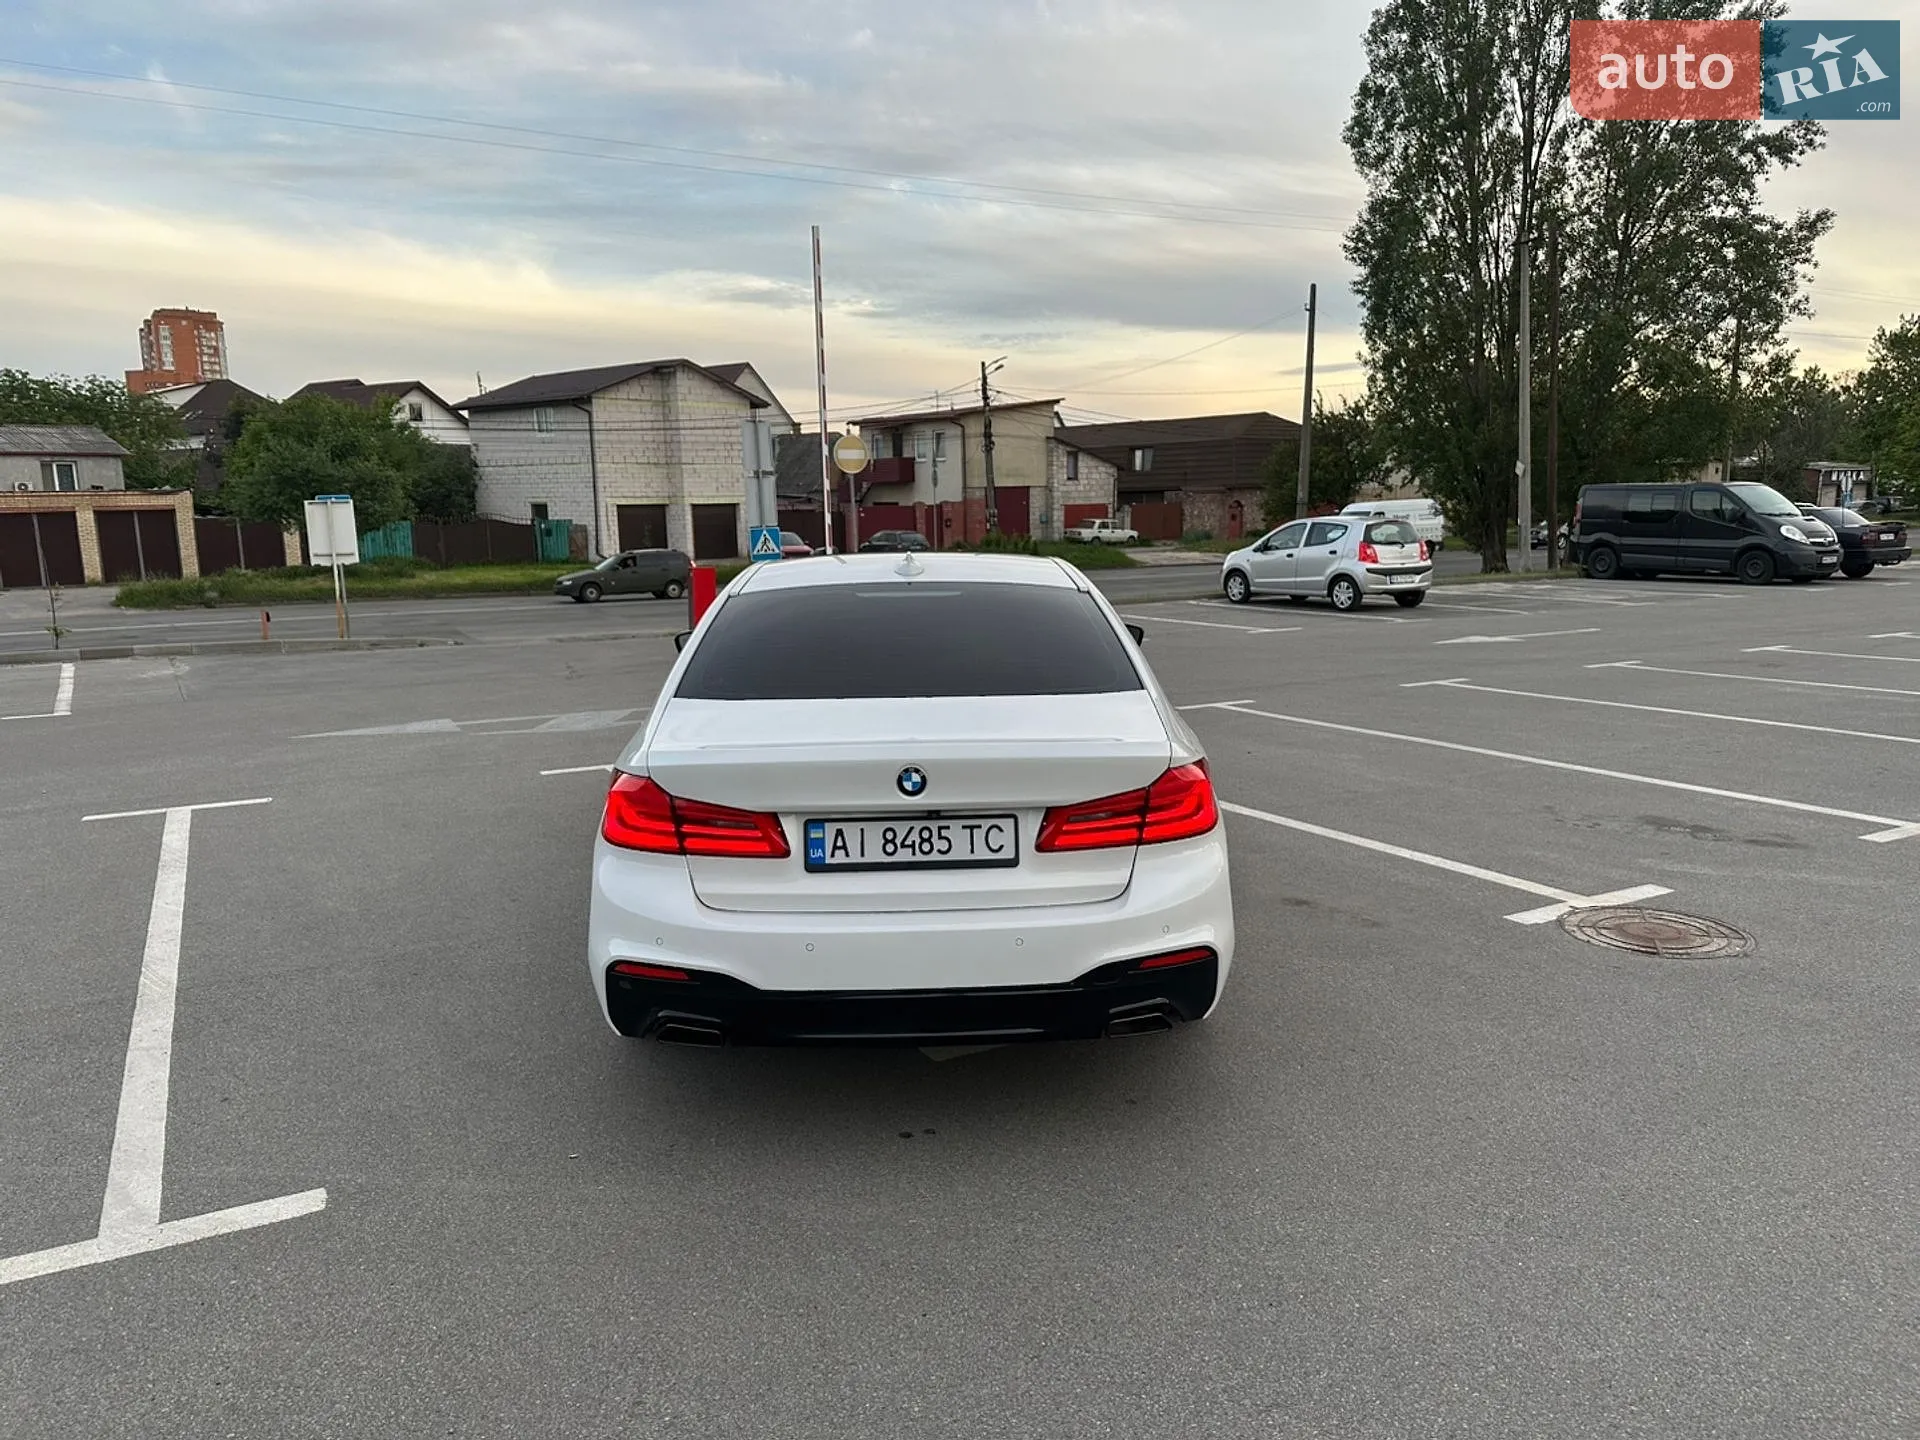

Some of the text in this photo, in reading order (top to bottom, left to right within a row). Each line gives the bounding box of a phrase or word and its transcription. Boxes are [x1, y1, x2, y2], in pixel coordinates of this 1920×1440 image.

[830, 823, 1005, 858] AI 8485 TC
[810, 848, 824, 858] UA
